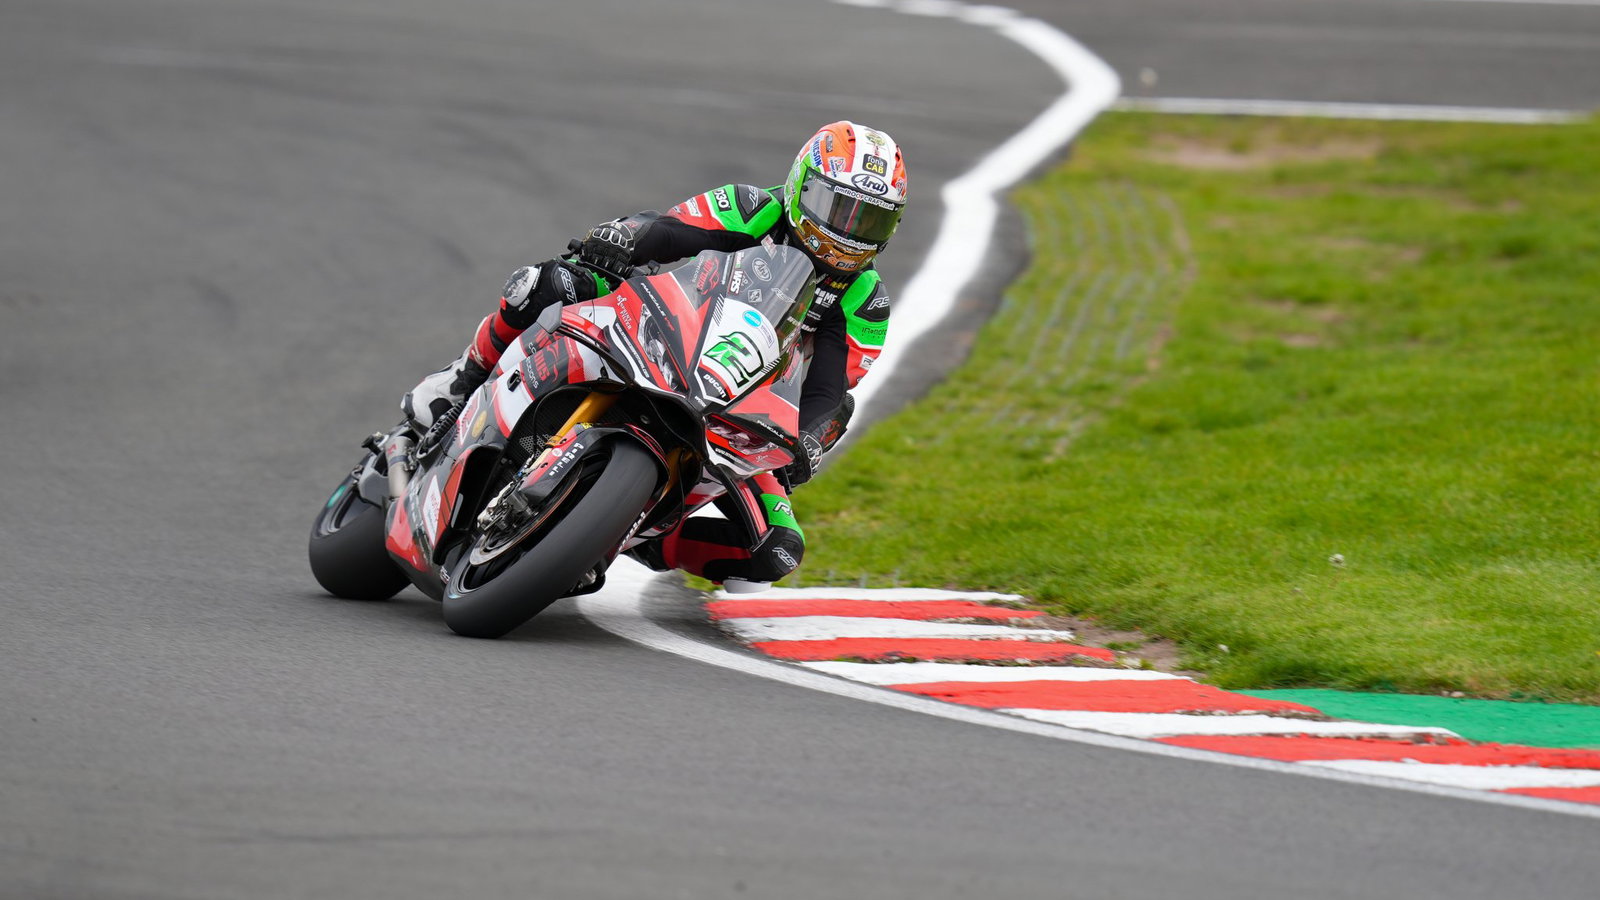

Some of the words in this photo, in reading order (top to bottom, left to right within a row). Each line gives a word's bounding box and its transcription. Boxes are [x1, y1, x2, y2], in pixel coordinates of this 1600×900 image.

[865, 162, 884, 174] CAB
[859, 175, 885, 193] Arai
[730, 271, 743, 294] WRS
[704, 331, 764, 388] 2
[703, 374, 726, 398] DUCATI
[549, 442, 584, 476] PIRELLI
